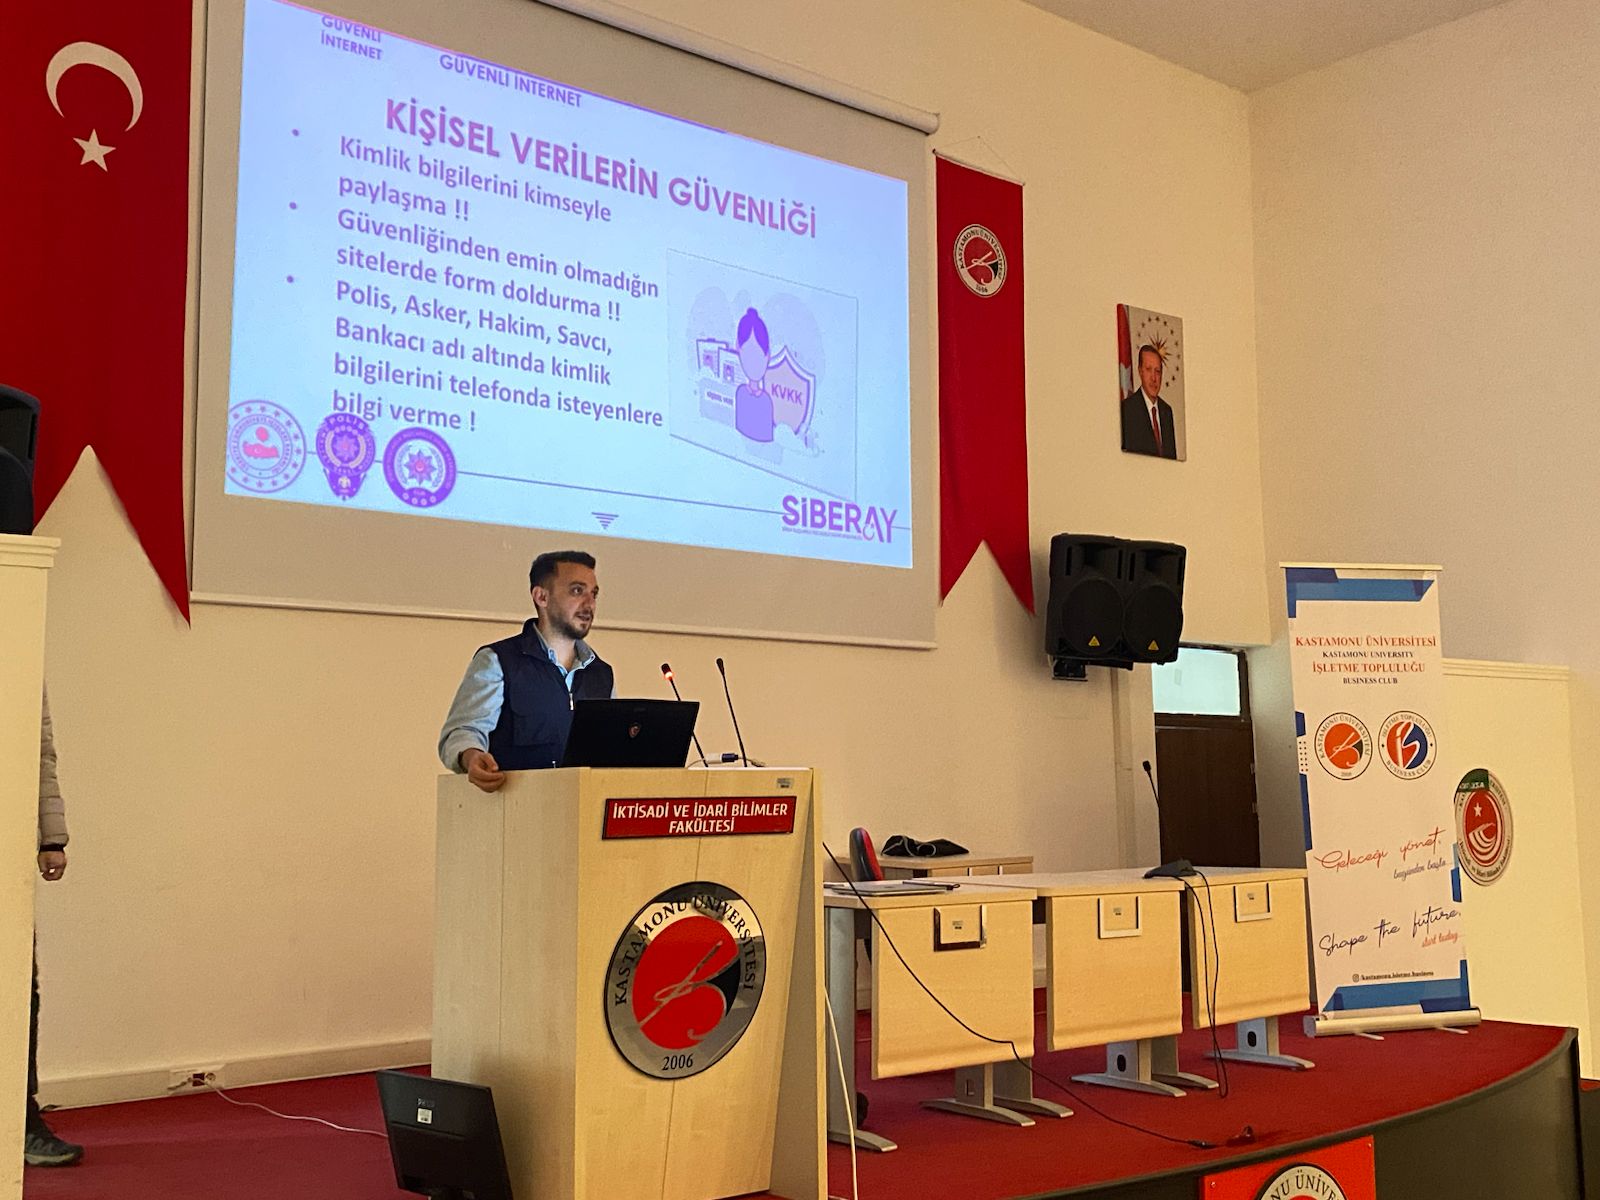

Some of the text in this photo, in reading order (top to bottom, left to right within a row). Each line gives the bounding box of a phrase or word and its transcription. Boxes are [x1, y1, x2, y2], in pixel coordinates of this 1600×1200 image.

[340, 135, 612, 222] Kimlik bilgilerini kimseyle
[386, 98, 817, 238] KİŞİSEL VERİLERİN GÜVENLİĞİ
[338, 175, 470, 221] paylaşma !!
[337, 208, 659, 298] Güvenliğinden emin olmadığın
[336, 246, 621, 321] sitelerde form doldurma !!
[336, 280, 612, 356] Polis, Asker, Hakim, Savcı,
[335, 316, 611, 386] Bankacı adı altında kimlik
[332, 389, 476, 431] bilgi verme !
[333, 352, 663, 427] bilgilerini telefonda isteyenlere
[770, 382, 803, 406] KVKK
[1295, 635, 1437, 647] KASTAMONU ÜNİVERSİTESİ
[1312, 661, 1425, 675] İŞLETME TOPLULUĞU
[613, 801, 788, 819] İKTİSADİ VE İDARİ BİLİMLER
[669, 817, 735, 833] FAKÜLTESİ
[614, 900, 688, 1006] KASTAMONU
[1318, 931, 1368, 956] Shape
[1374, 918, 1401, 948] the
[662, 1054, 694, 1072] 2006
